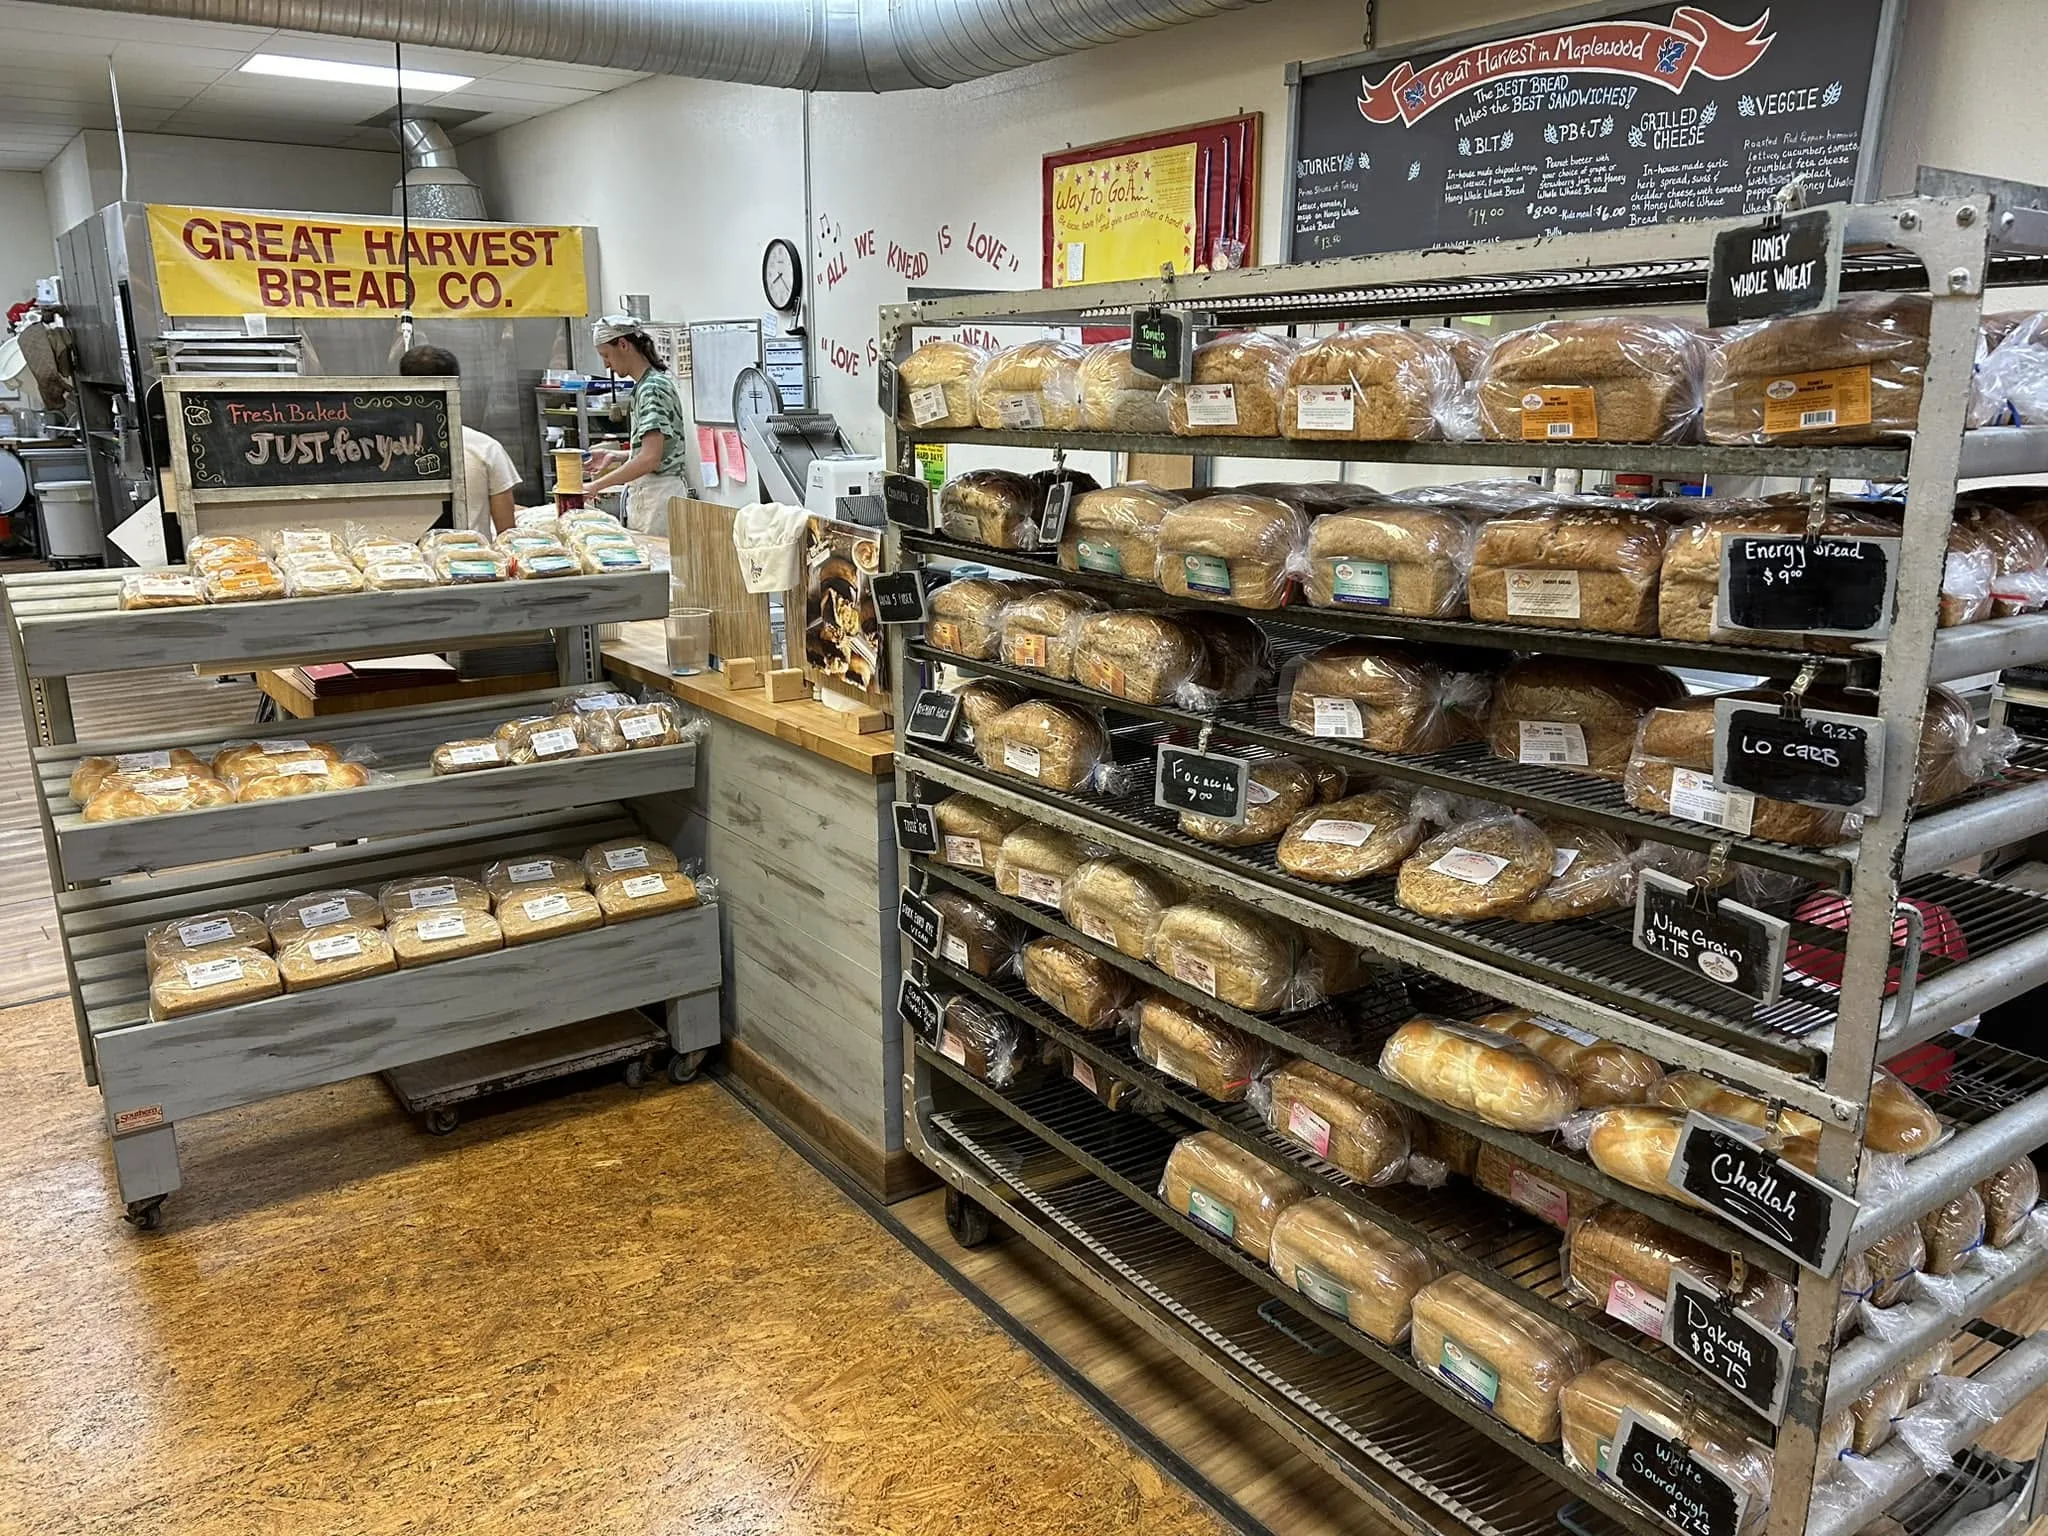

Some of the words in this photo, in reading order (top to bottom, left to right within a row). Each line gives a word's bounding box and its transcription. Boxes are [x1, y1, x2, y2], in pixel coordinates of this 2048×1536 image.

[1428, 60, 1471, 98] Great
[1476, 40, 1535, 75] Harvest
[1538, 47, 1550, 61] in
[1554, 32, 1651, 64] Maplewood
[1474, 88, 1493, 104] The
[1494, 78, 1529, 98] BEST
[1529, 75, 1568, 94] BREAD
[1756, 87, 1819, 115] VEGGIE
[1455, 105, 1487, 131] Makes
[1489, 101, 1509, 114] the
[1512, 95, 1544, 113] BEST
[1548, 86, 1637, 109] SANDWICHES!
[1640, 108, 1697, 131] GRILLED
[1474, 135, 1500, 154] BLT
[1654, 125, 1706, 150] CHEESE
[1744, 137, 1777, 150] Roasted
[1783, 132, 1797, 144] Red
[1782, 146, 1826, 158] cucumber,
[1828, 142, 1860, 154] tomato,
[1302, 154, 1344, 176] TURKEY
[1545, 156, 1568, 168] Peanut
[1558, 168, 1578, 178] choice
[1643, 163, 1680, 177] In-house
[1682, 160, 1704, 171] made
[1707, 158, 1729, 172] garlic
[1752, 159, 1792, 174] crumbled
[1796, 157, 1816, 168] feta
[1818, 156, 1849, 166] cheese
[1504, 184, 1526, 197] Bread
[1559, 187, 1583, 197] Wheat
[1584, 183, 1608, 194] Bread
[1604, 174, 1627, 187] Honey
[1630, 189, 1663, 201] cheddar
[1715, 184, 1743, 194] tomato
[1637, 178, 1655, 189] herb
[1746, 186, 1775, 202] pepper
[1827, 176, 1856, 189] Whole
[1748, 176, 1767, 186] with
[1056, 187, 1085, 215] Way
[1091, 184, 1103, 205] to
[1526, 203, 1557, 220] $8.00
[1643, 200, 1668, 213] Honey
[1669, 198, 1695, 209] Whole
[1697, 197, 1725, 208] Wheat
[1629, 211, 1658, 226] Bread
[181, 218, 342, 263] GREAT
[364, 226, 560, 267] HARVEST
[854, 230, 875, 259] WE
[887, 240, 929, 280] KNEAD
[937, 225, 952, 255] IS
[1752, 233, 1790, 264] HONEY
[256, 268, 418, 310] BREAD
[438, 272, 513, 309] CO.
[1730, 270, 1768, 298] WHOLE
[1773, 260, 1816, 292] WHEAT
[1141, 324, 1165, 342] Tomato
[866, 338, 878, 367] IS
[1152, 344, 1167, 361] Herb
[227, 402, 284, 425] Fresh
[289, 401, 352, 423] Baked
[245, 432, 330, 465] JUST
[331, 426, 374, 464] for
[375, 422, 424, 472] you!
[1745, 542, 1806, 568] Energy
[1742, 735, 1772, 755] LO
[1173, 759, 1235, 792] Focaccia
[1646, 928, 1689, 959] $7.75
[1653, 912, 1689, 941] Nine
[1691, 929, 1743, 963] Grain
[1711, 1153, 1799, 1221] Challah
[1684, 1295, 1752, 1367] Dakota
[1691, 1331, 1746, 1389] $8.75
[1656, 1443, 1702, 1484] White
[1632, 1452, 1709, 1522] Sourdough
[1667, 1503, 1711, 1535] $7.25
